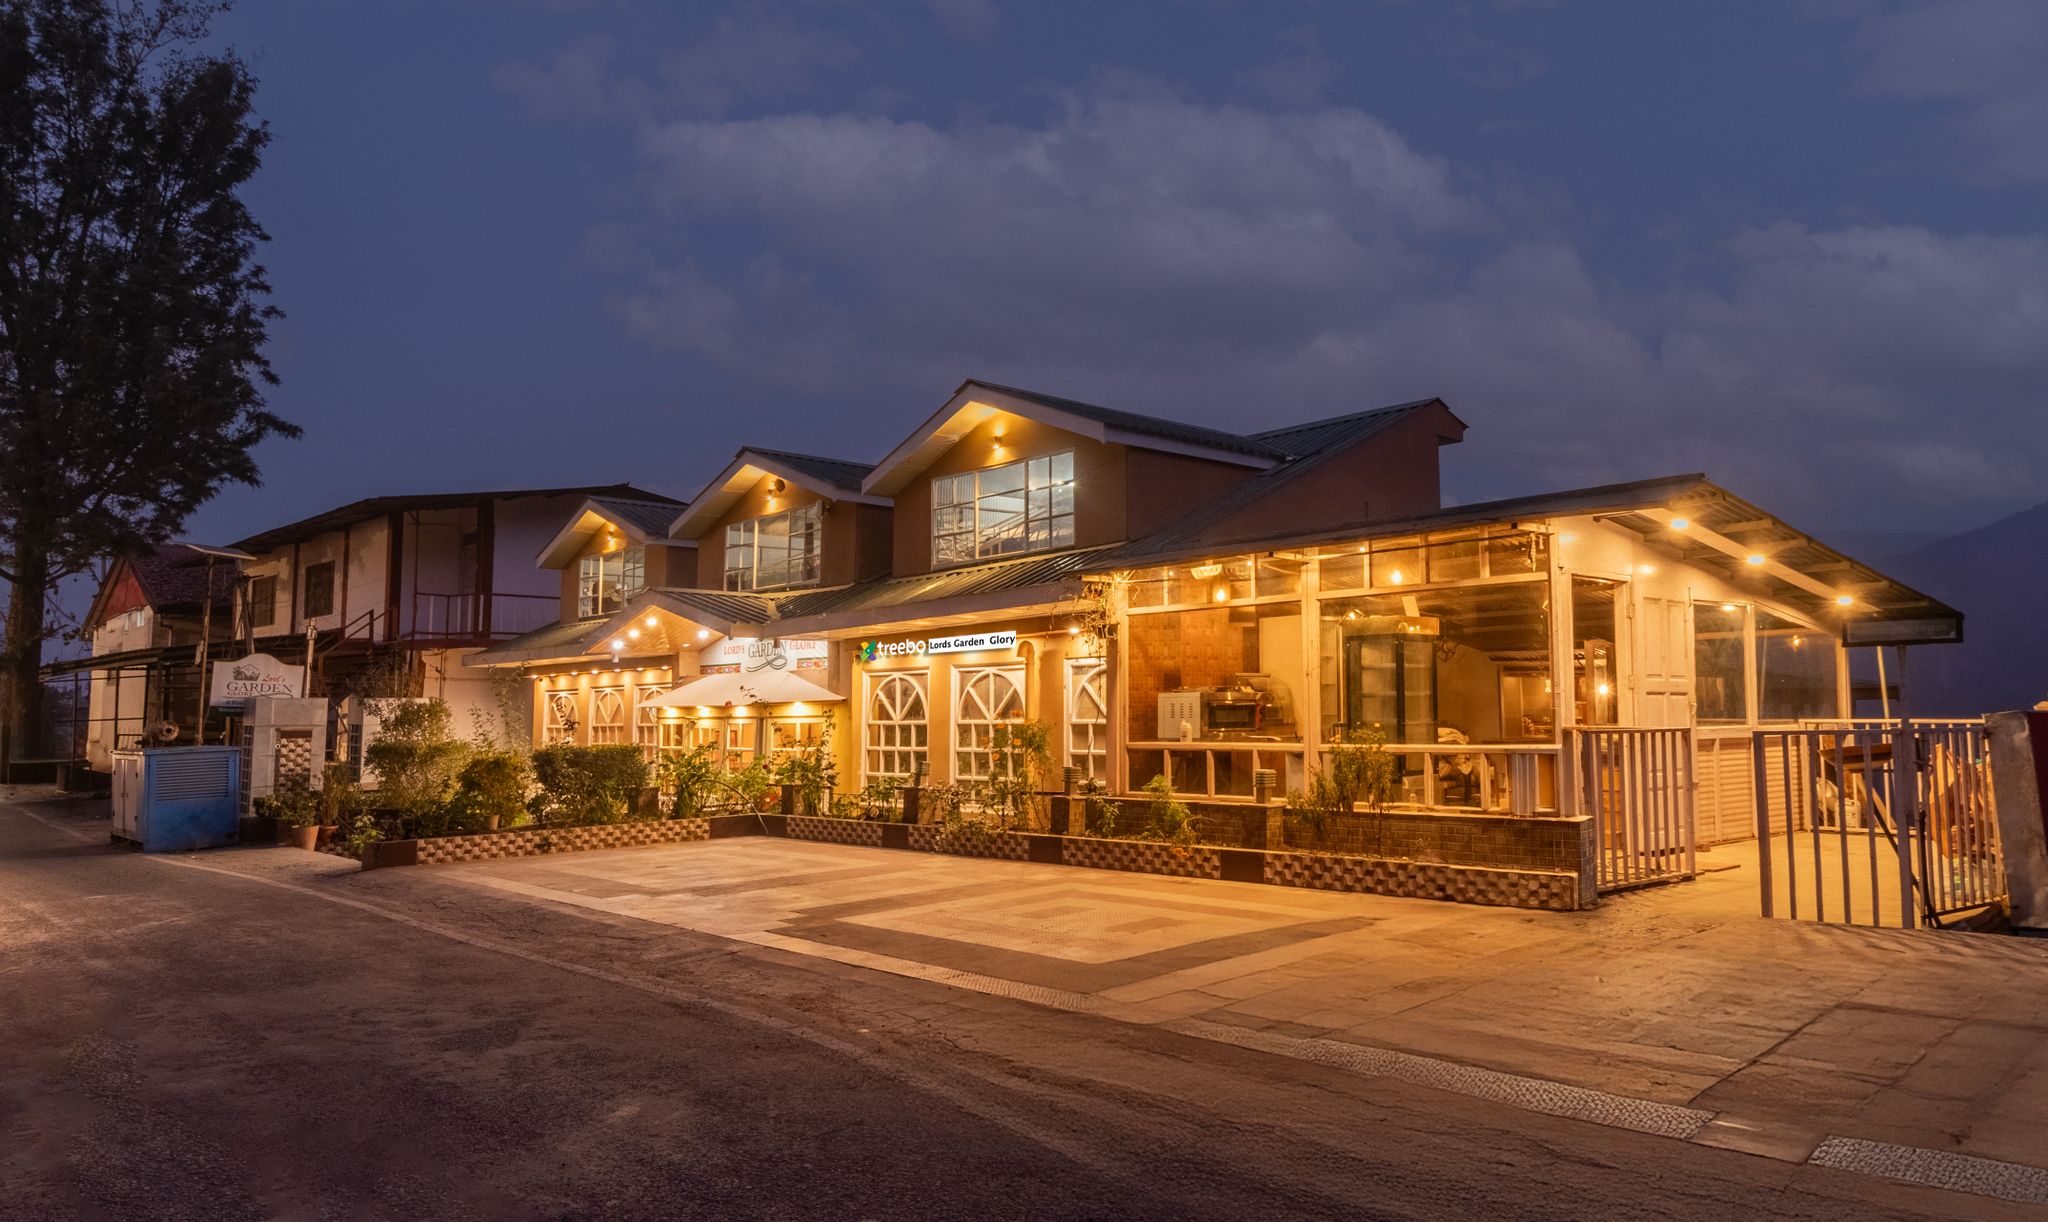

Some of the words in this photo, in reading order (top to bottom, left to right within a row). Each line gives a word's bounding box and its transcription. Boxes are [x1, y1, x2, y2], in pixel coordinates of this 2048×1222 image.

[877, 639, 926, 656] treebo
[929, 640, 951, 649] Lords
[953, 637, 985, 648] Garden
[989, 636, 1015, 645] Glory
[227, 682, 292, 693] GARDEN
